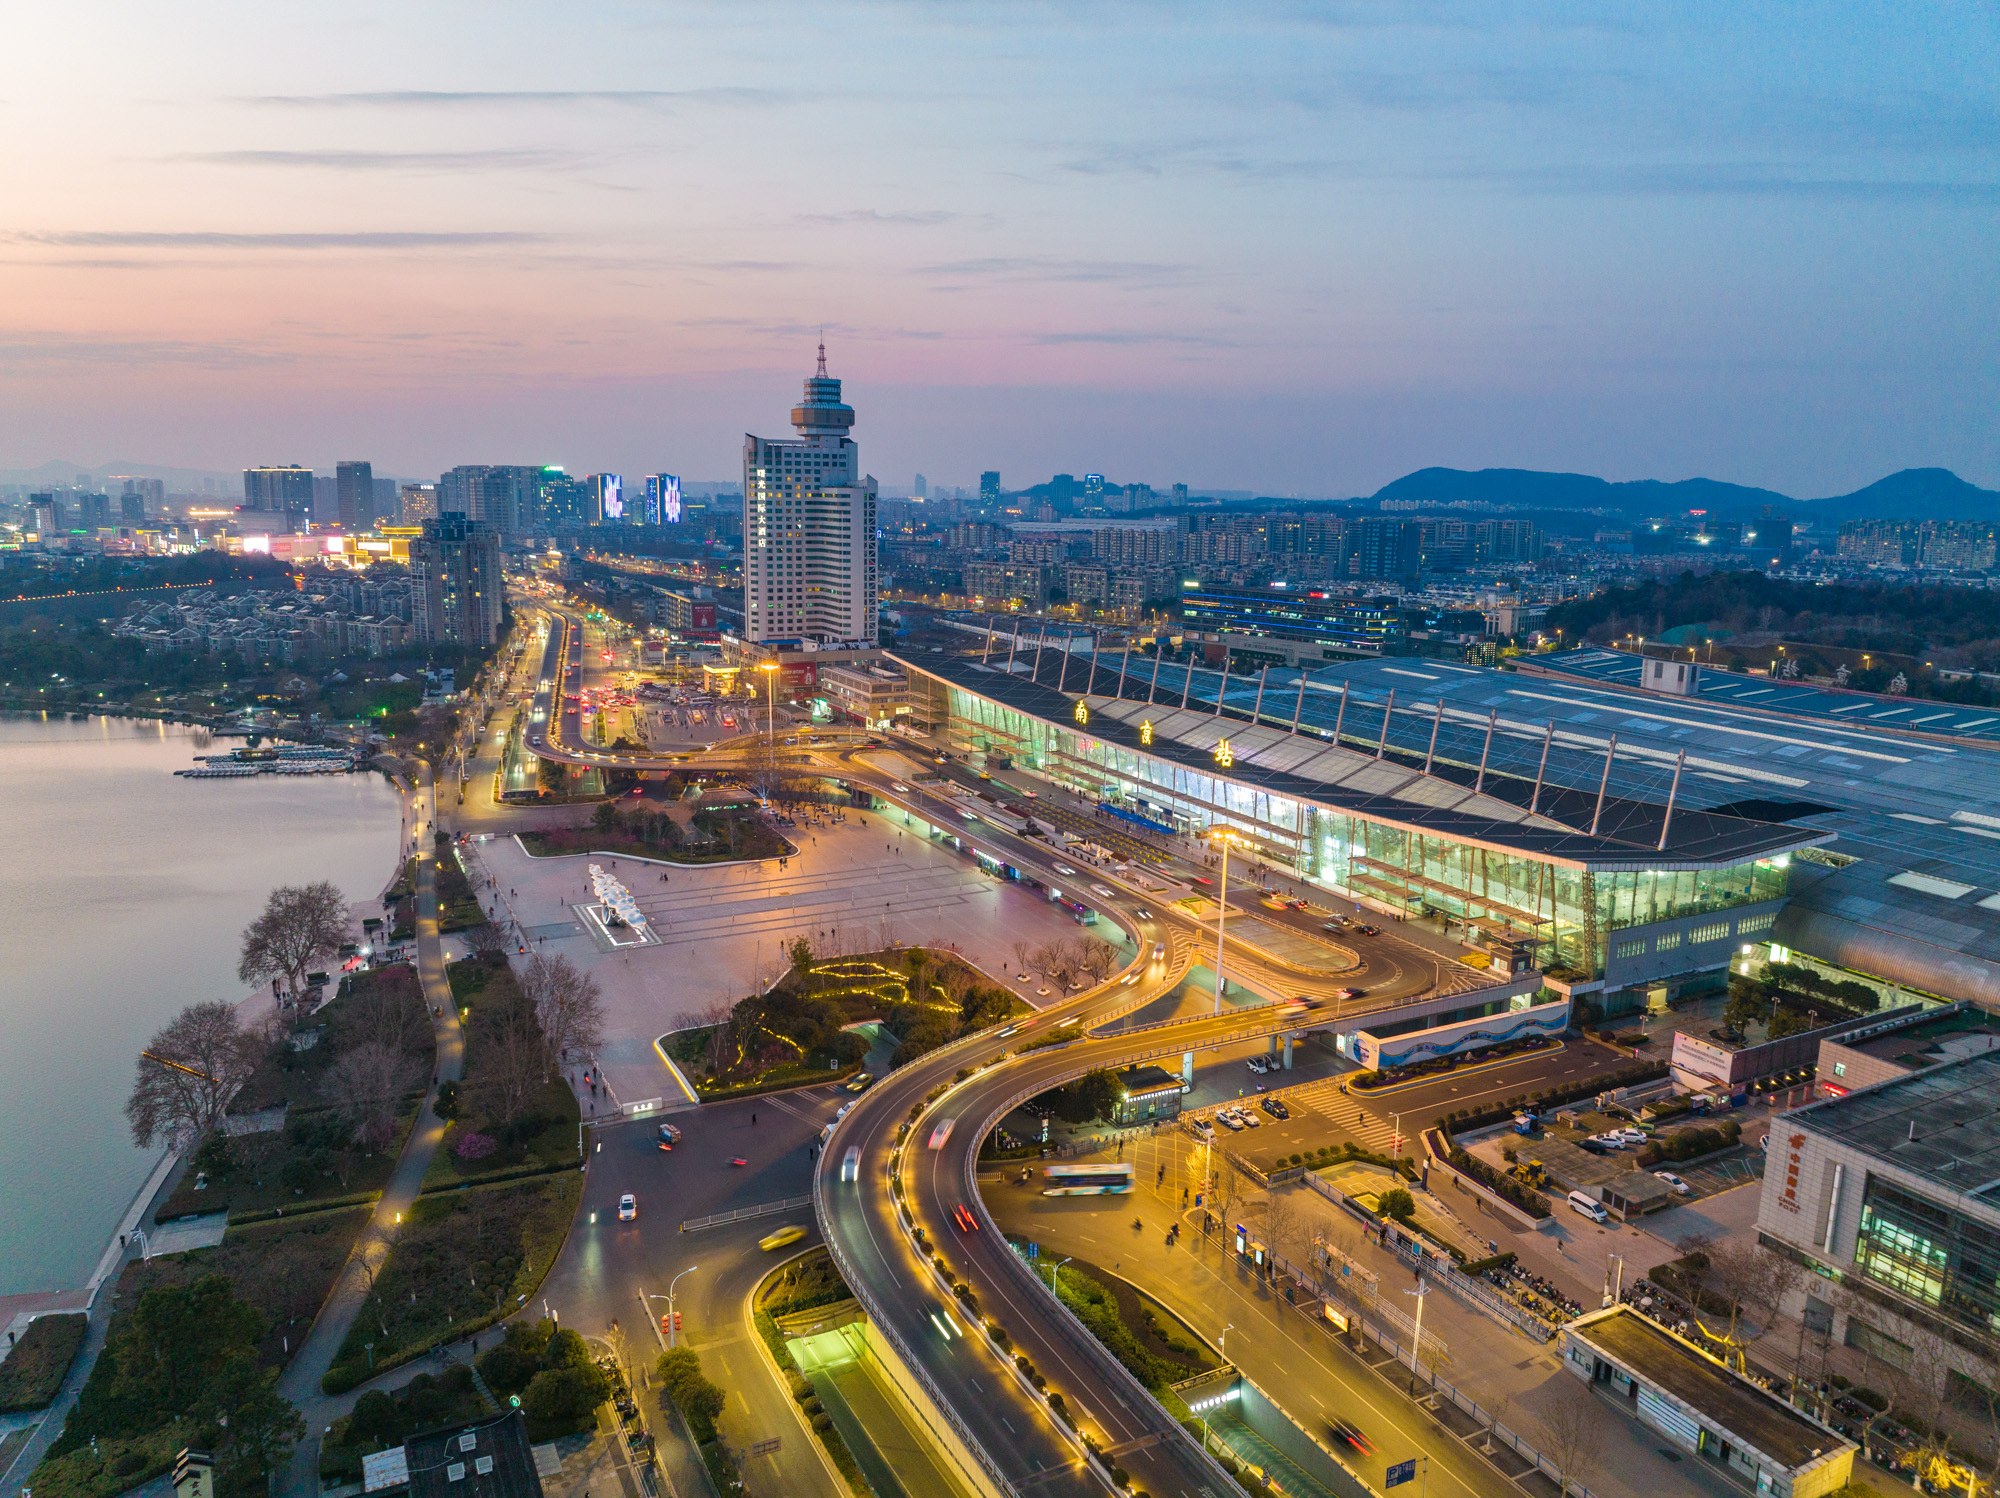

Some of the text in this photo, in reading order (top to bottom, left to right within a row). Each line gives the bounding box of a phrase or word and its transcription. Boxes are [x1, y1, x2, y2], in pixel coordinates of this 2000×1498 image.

[757, 469, 767, 548] 曙光国际大酒店
[1075, 699, 1234, 767] 南京站
[1777, 1195, 1801, 1210] CHINA
[1778, 1202, 1799, 1214] POST
